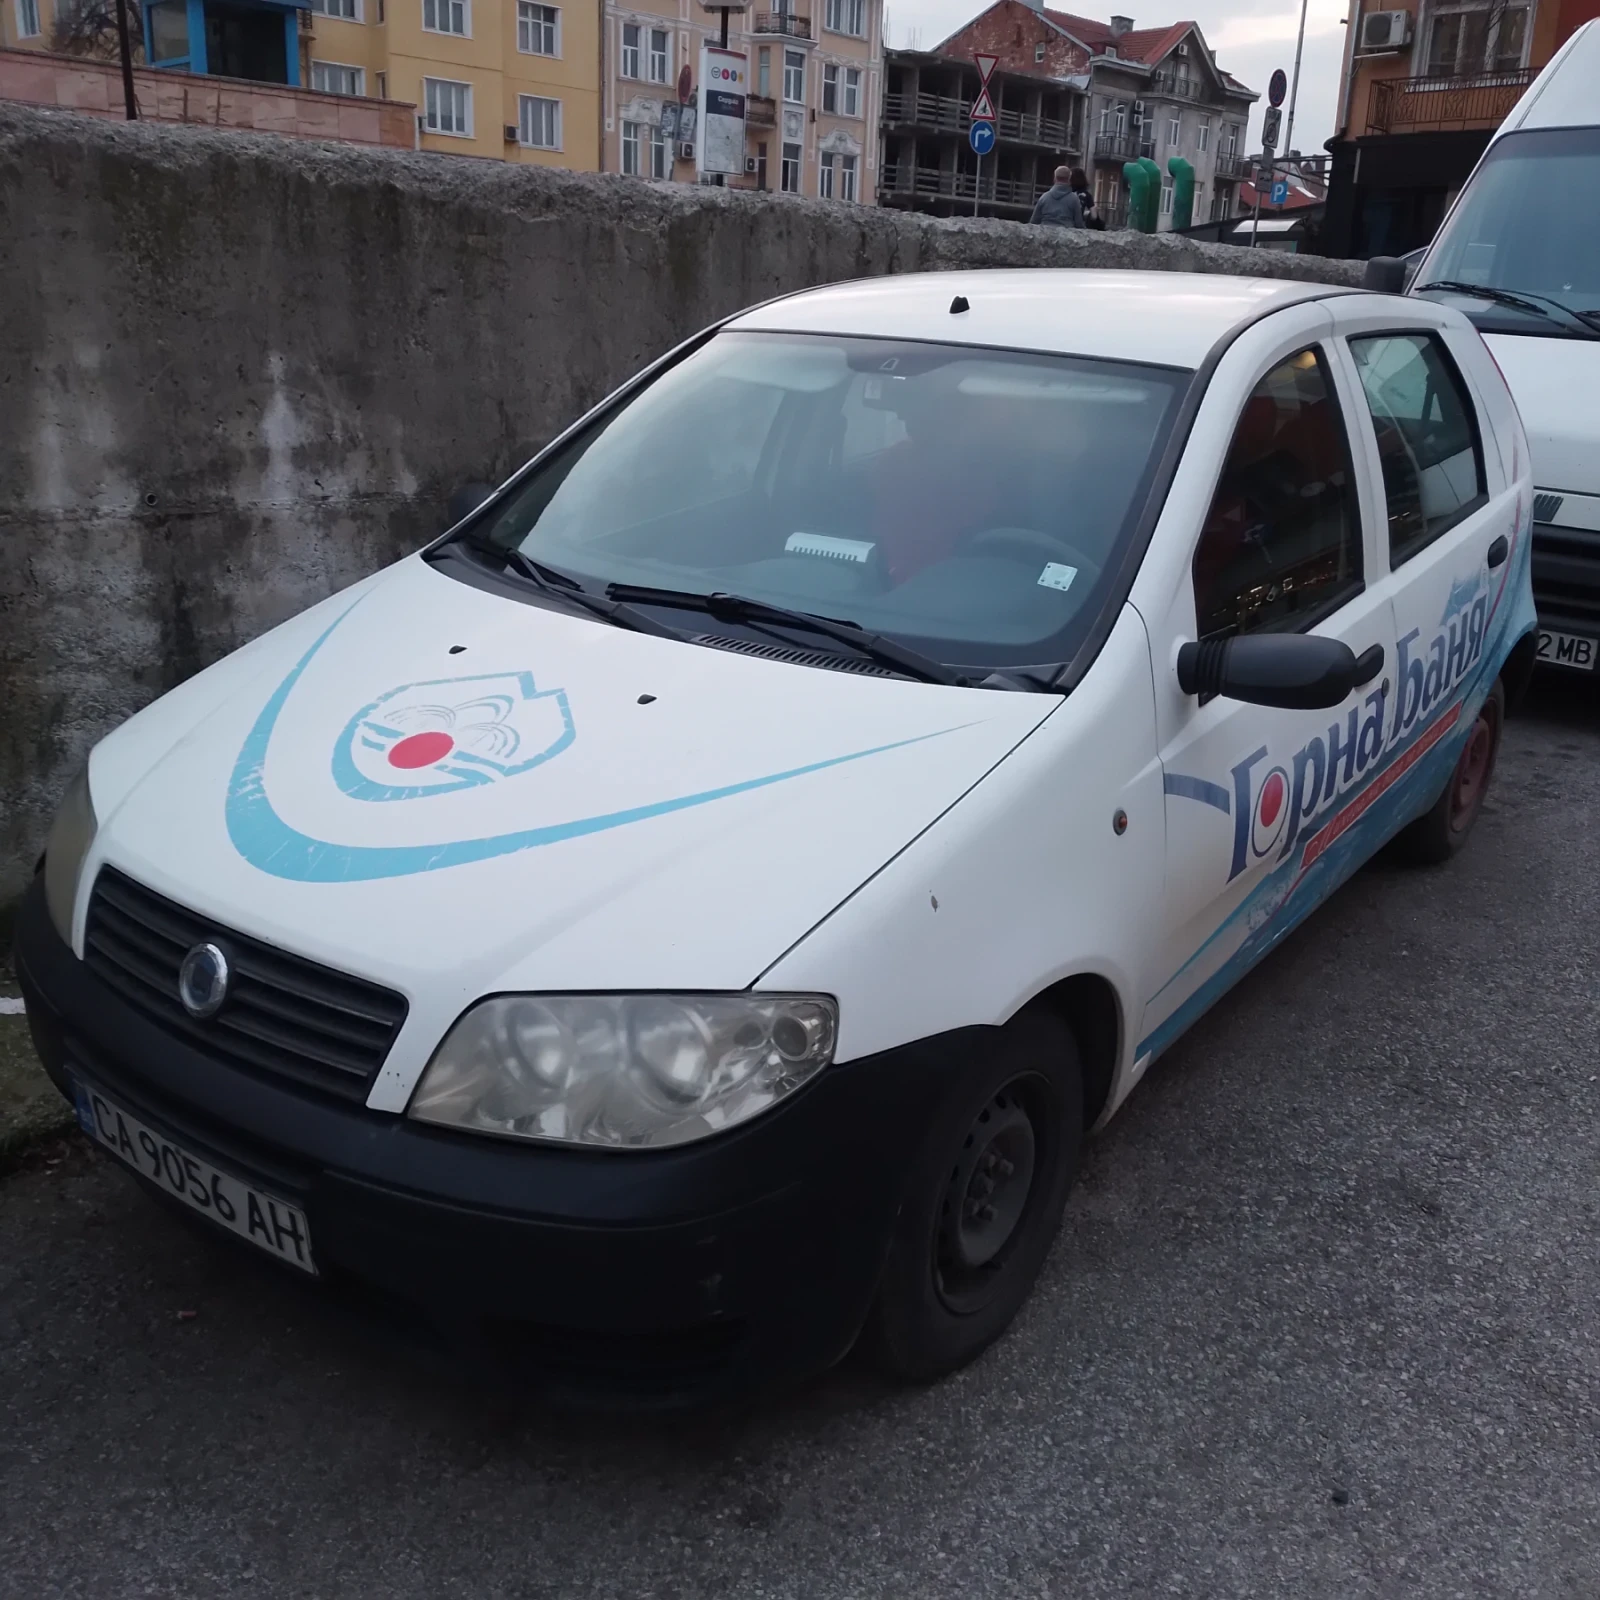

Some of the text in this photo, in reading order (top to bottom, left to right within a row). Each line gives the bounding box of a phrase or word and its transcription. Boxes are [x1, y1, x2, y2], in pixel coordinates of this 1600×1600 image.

[1555, 636, 1592, 664] MB
[1226, 687, 1387, 884] Горна
[1390, 592, 1488, 742] Баня
[91, 1094, 305, 1262] CA 9056 AH
